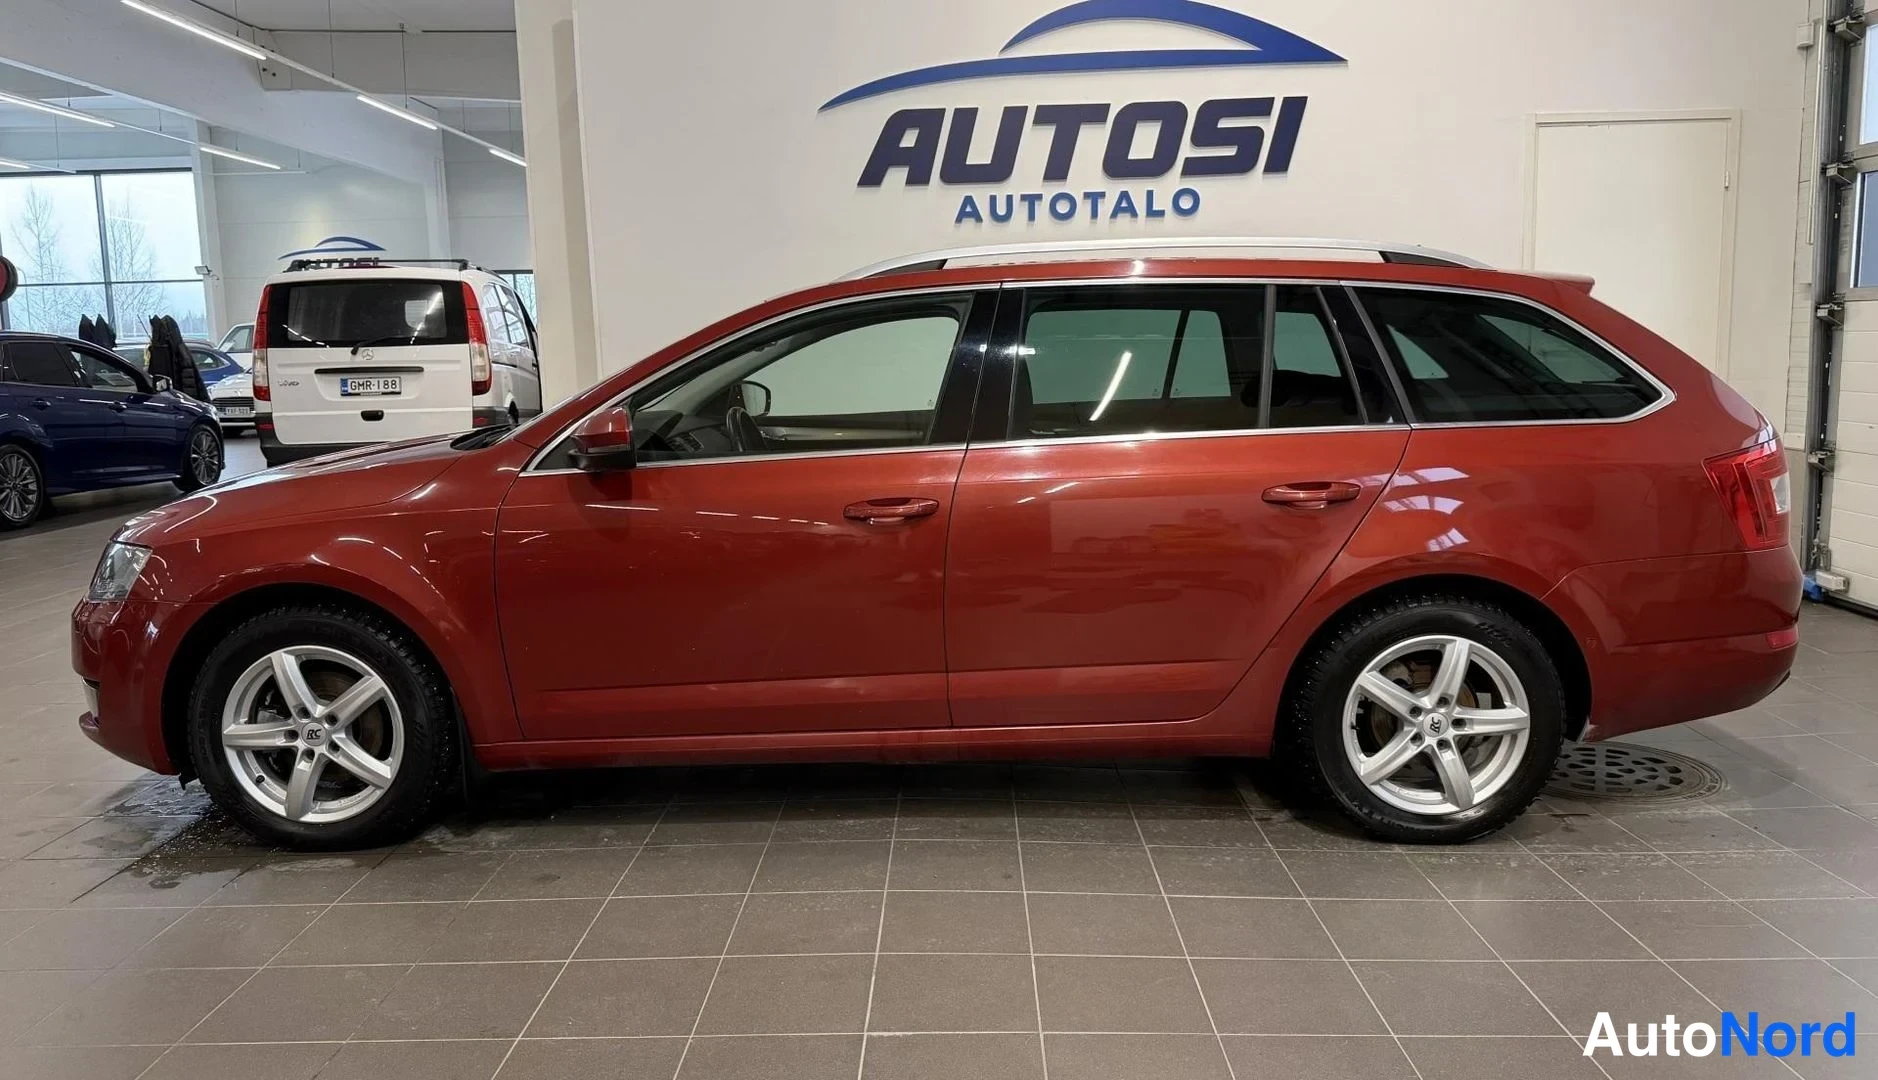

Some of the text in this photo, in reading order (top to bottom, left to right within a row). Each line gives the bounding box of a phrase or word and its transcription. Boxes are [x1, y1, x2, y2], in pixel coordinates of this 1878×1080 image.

[856, 96, 1309, 187] AUTOSI
[954, 187, 1201, 224] AUTOTALO
[350, 379, 398, 391] GMR-188
[306, 728, 322, 740] RC
[1429, 716, 1442, 735] RC
